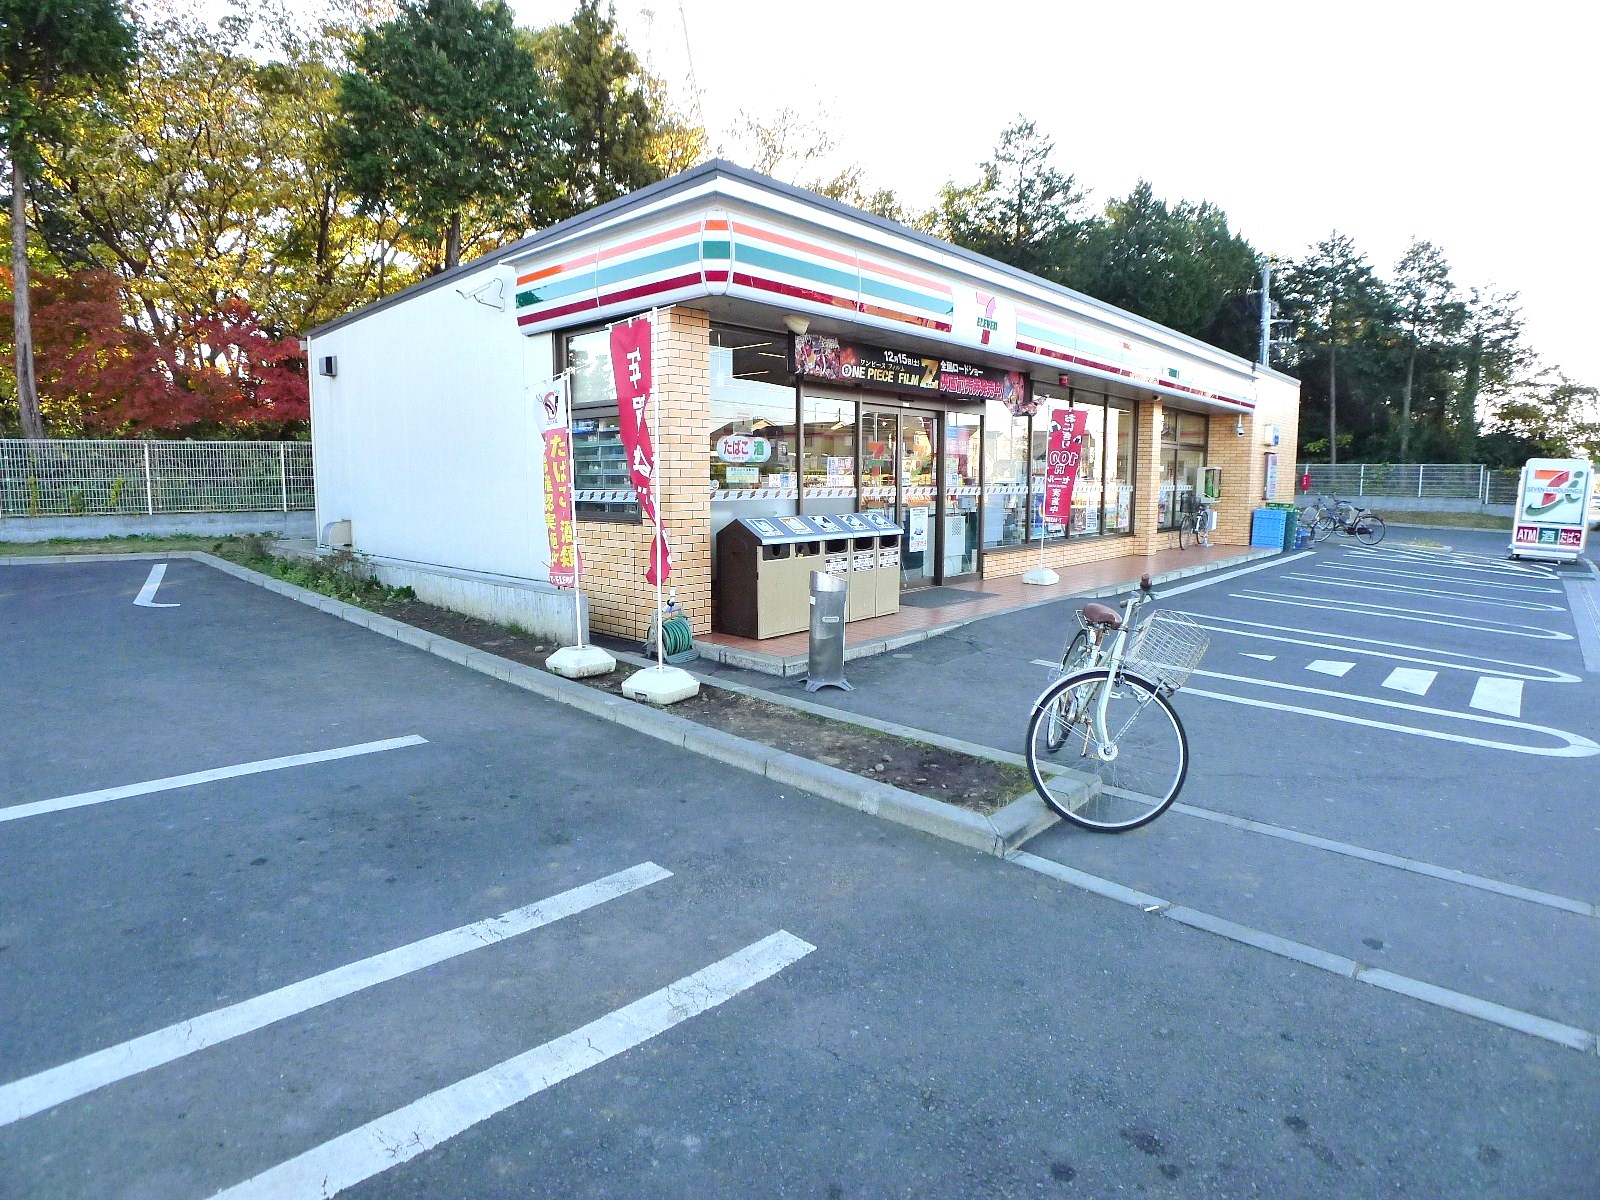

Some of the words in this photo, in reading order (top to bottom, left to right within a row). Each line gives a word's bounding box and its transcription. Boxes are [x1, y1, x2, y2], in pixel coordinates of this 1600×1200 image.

[860, 359, 886, 370] ワンピース
[940, 360, 984, 377] 全国ロードショー
[842, 364, 866, 379] ONE
[867, 368, 895, 383] PIECE
[898, 373, 919, 386] FILM
[920, 358, 939, 389] Z
[723, 439, 749, 455] たばこ
[753, 440, 764, 456] 酒
[1517, 528, 1537, 541] ATM
[1541, 530, 1556, 542] 酒
[1560, 532, 1582, 544] たばこ
